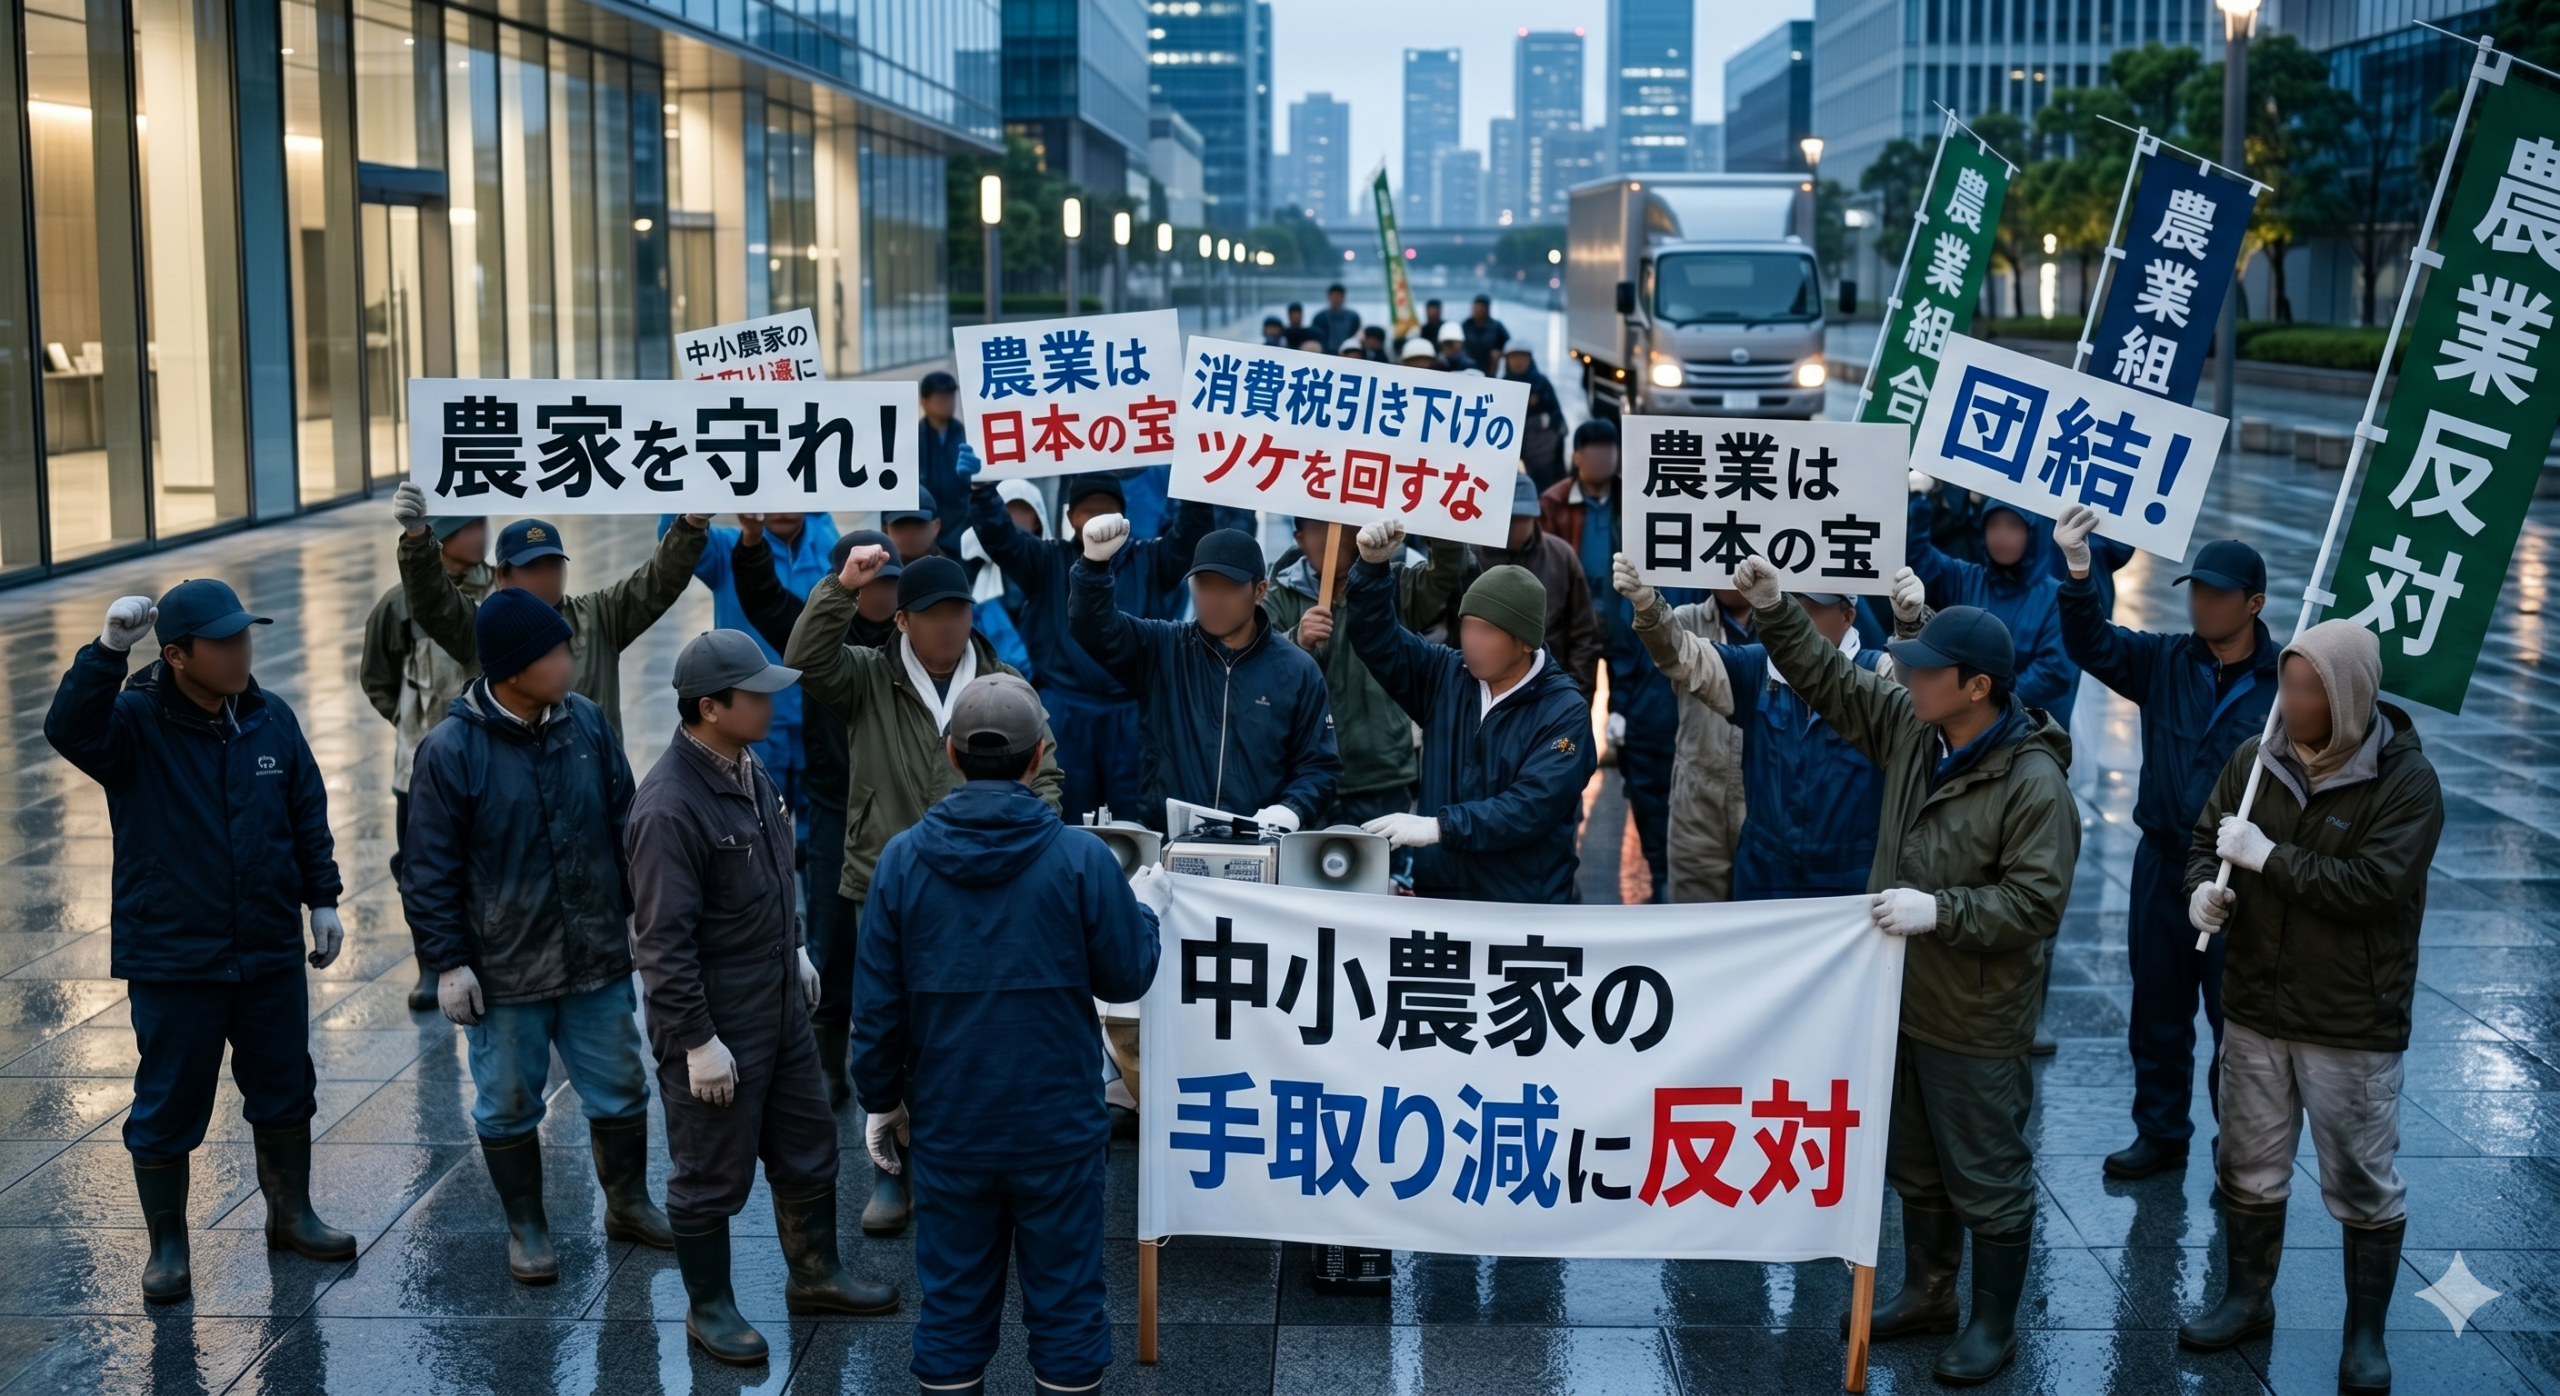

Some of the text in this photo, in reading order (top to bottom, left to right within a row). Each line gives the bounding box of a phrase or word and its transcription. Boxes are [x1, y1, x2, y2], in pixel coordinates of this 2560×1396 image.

[1887, 167, 1988, 425] 農業組合
[2112, 189, 2217, 395] 農業組
[686, 325, 808, 366] 中小農家の
[980, 330, 1150, 400] 農業は
[982, 395, 1176, 465] 日本の宝
[1192, 352, 1514, 450] 消費税引き下げの
[1940, 365, 2192, 525] 団結!
[2347, 136, 2560, 656] 農業反対
[435, 396, 898, 498] 農家を守れ!
[1199, 432, 1489, 521] ツケを回すな
[1643, 430, 1839, 501] 農業は
[1645, 510, 1881, 580] 日本の宝
[1181, 917, 1673, 1056] 中小農家の
[1170, 1072, 1861, 1208] 手取り減に反対
